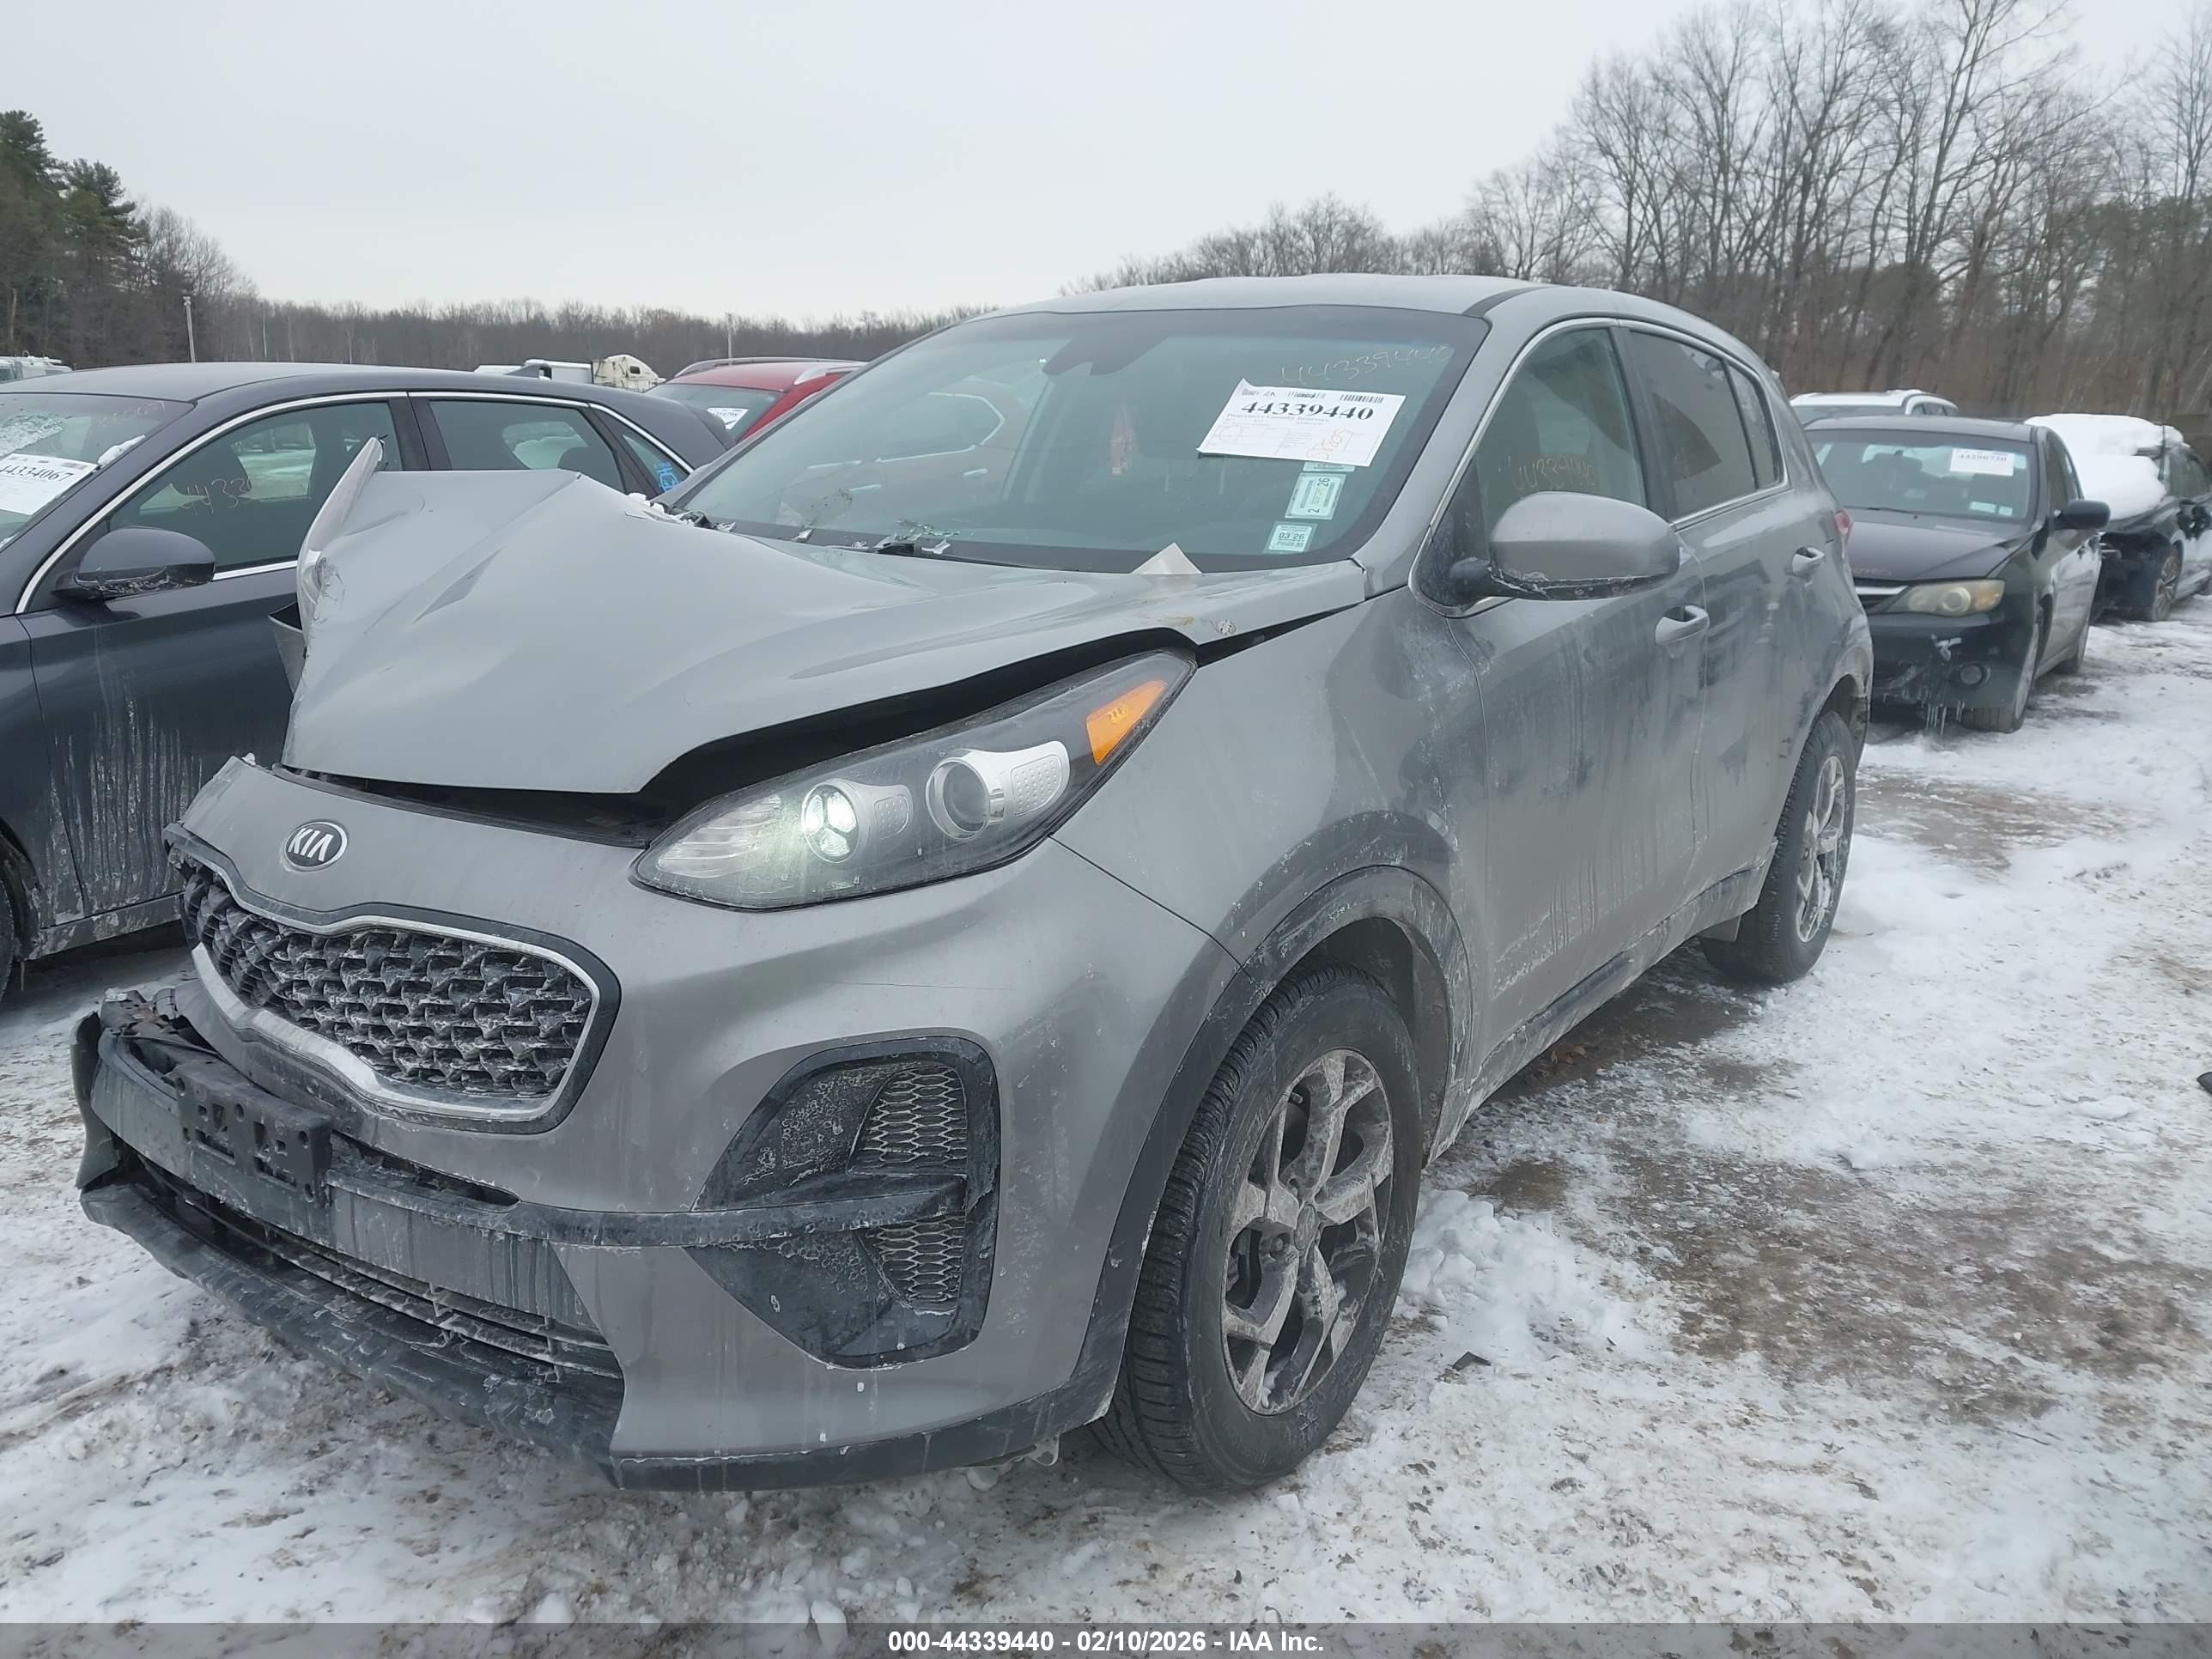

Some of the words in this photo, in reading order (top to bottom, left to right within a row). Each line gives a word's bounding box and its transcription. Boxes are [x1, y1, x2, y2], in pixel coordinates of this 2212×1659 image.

[1242, 401, 1375, 421] 44339440
[1317, 477, 1331, 487] 26
[288, 828, 334, 862] KIA
